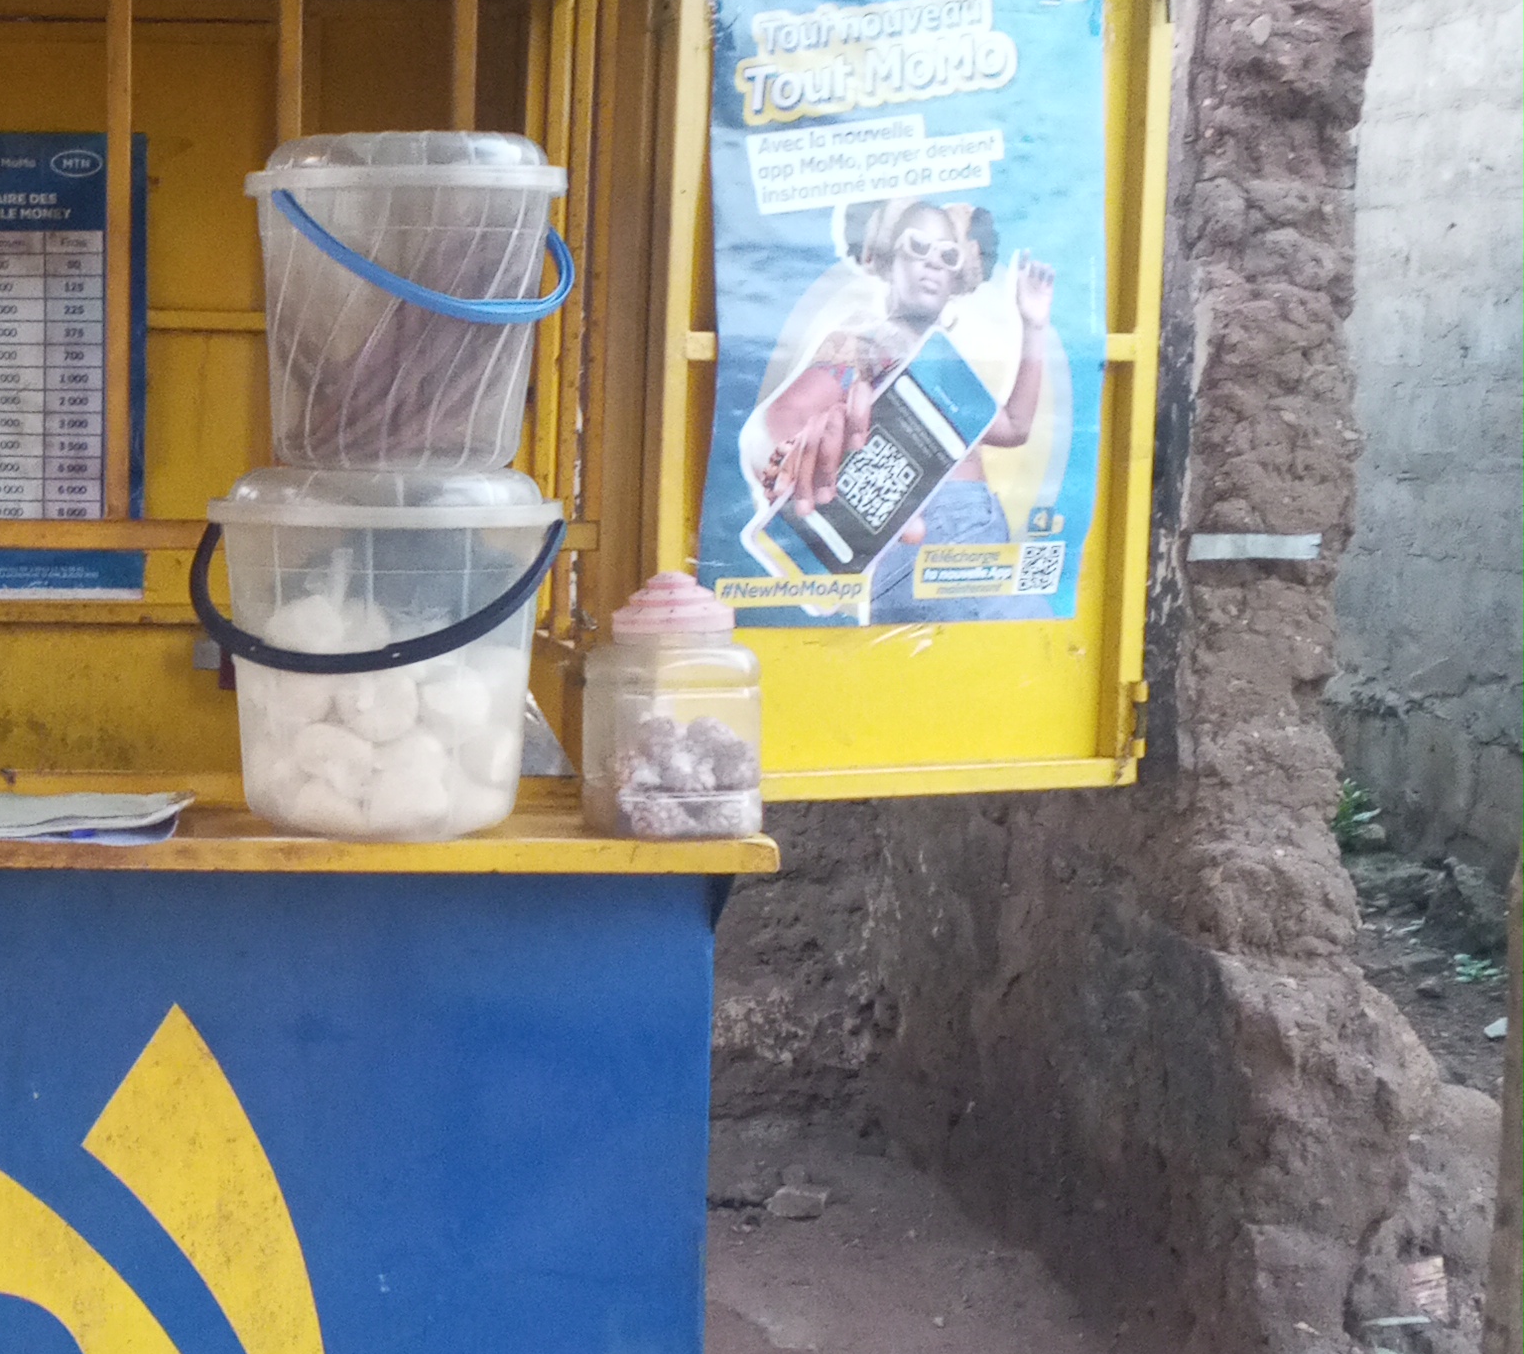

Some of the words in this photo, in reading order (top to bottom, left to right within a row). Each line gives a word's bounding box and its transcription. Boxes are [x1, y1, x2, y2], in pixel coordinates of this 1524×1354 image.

[744, 53, 854, 113] Tout
[865, 34, 1008, 96] MoMo
[758, 136, 804, 154] Avec
[809, 130, 827, 148] la
[832, 121, 914, 145] nouvelle
[758, 163, 794, 181] app
[800, 153, 861, 173] MoMo,
[866, 148, 920, 171] payer
[926, 136, 995, 159] devient
[29, 193, 57, 205] DES
[762, 172, 865, 203] instantané
[871, 172, 898, 190] via
[905, 167, 932, 185] QR
[939, 163, 983, 182] code
[21, 208, 72, 220] MONEY
[721, 580, 862, 600] #NewMoMoApp
